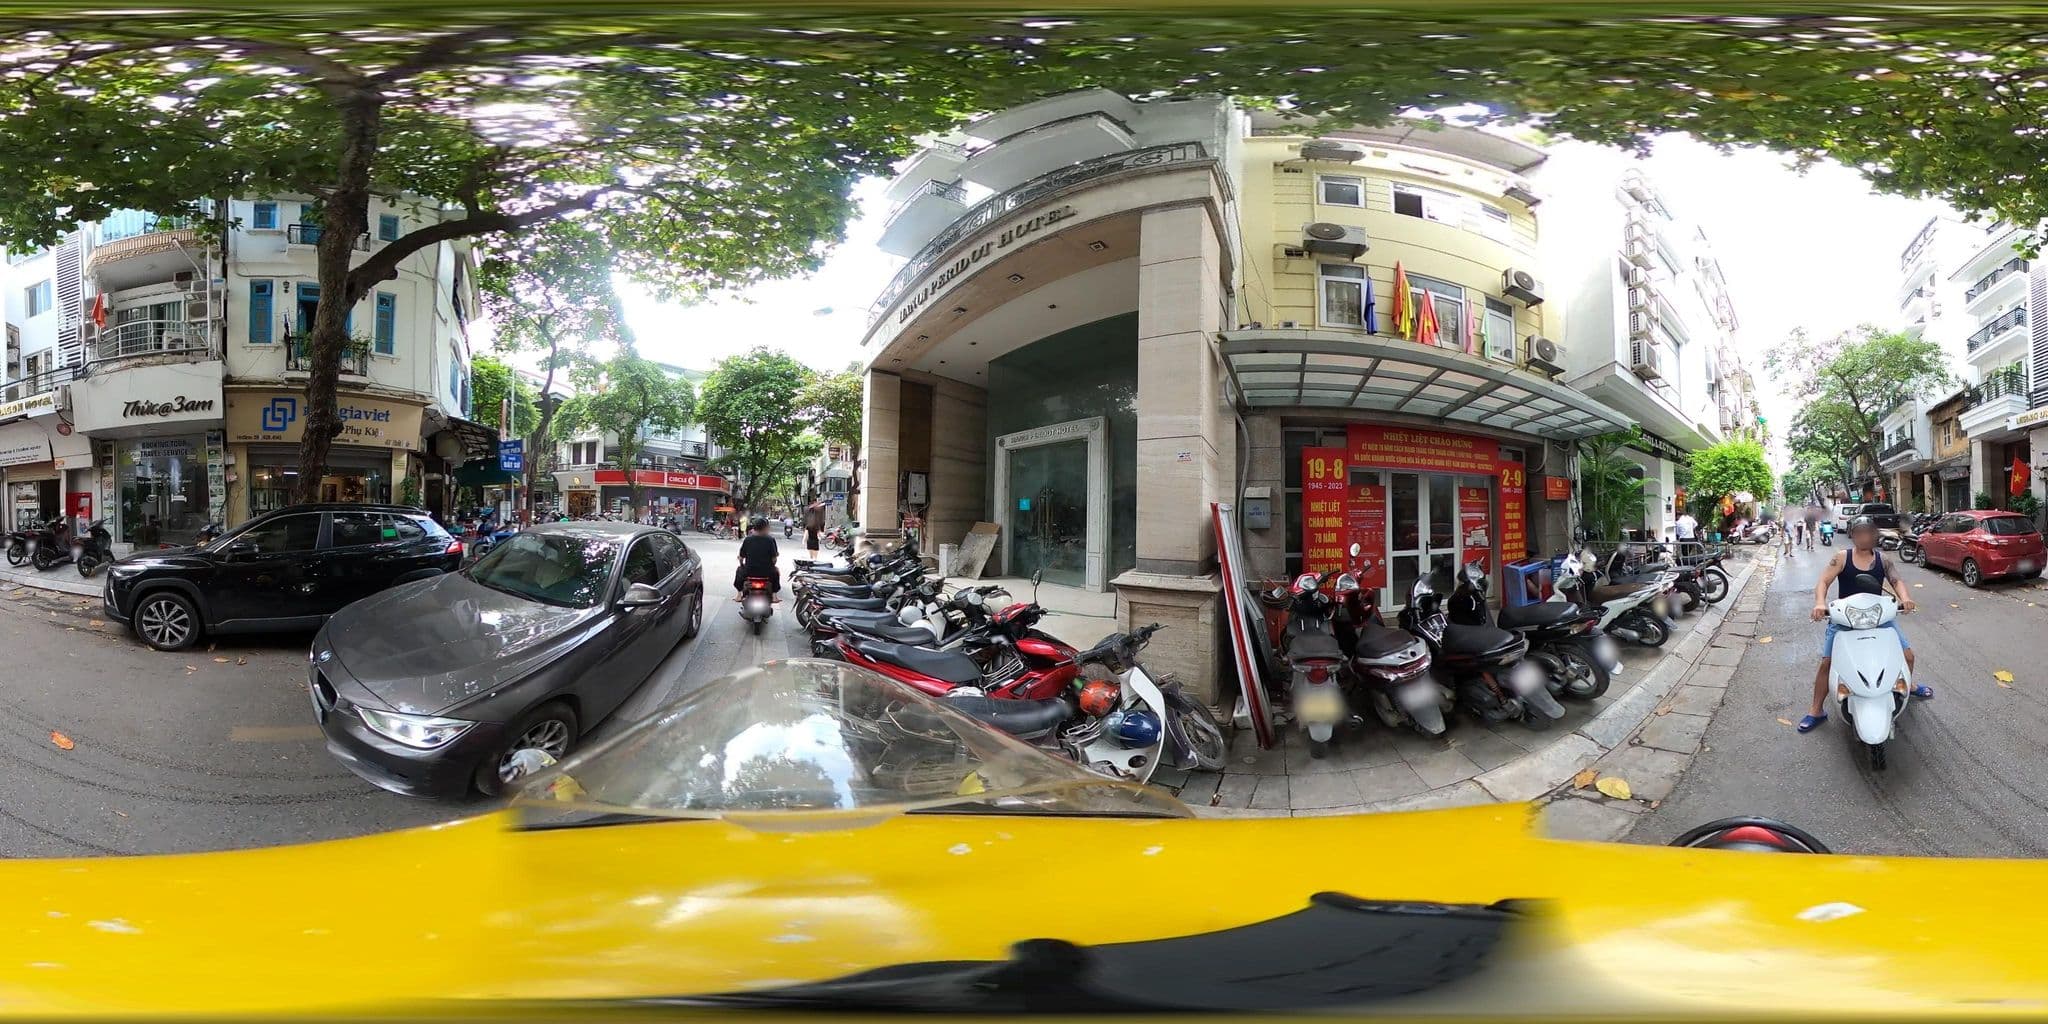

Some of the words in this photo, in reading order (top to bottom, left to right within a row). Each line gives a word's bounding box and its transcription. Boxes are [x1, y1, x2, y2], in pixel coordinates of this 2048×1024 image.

[998, 205, 1078, 249] HOTEL
[668, 476, 687, 484] CIRCLE
[1308, 482, 1322, 491] 1945
[1328, 482, 1343, 490] 2023
